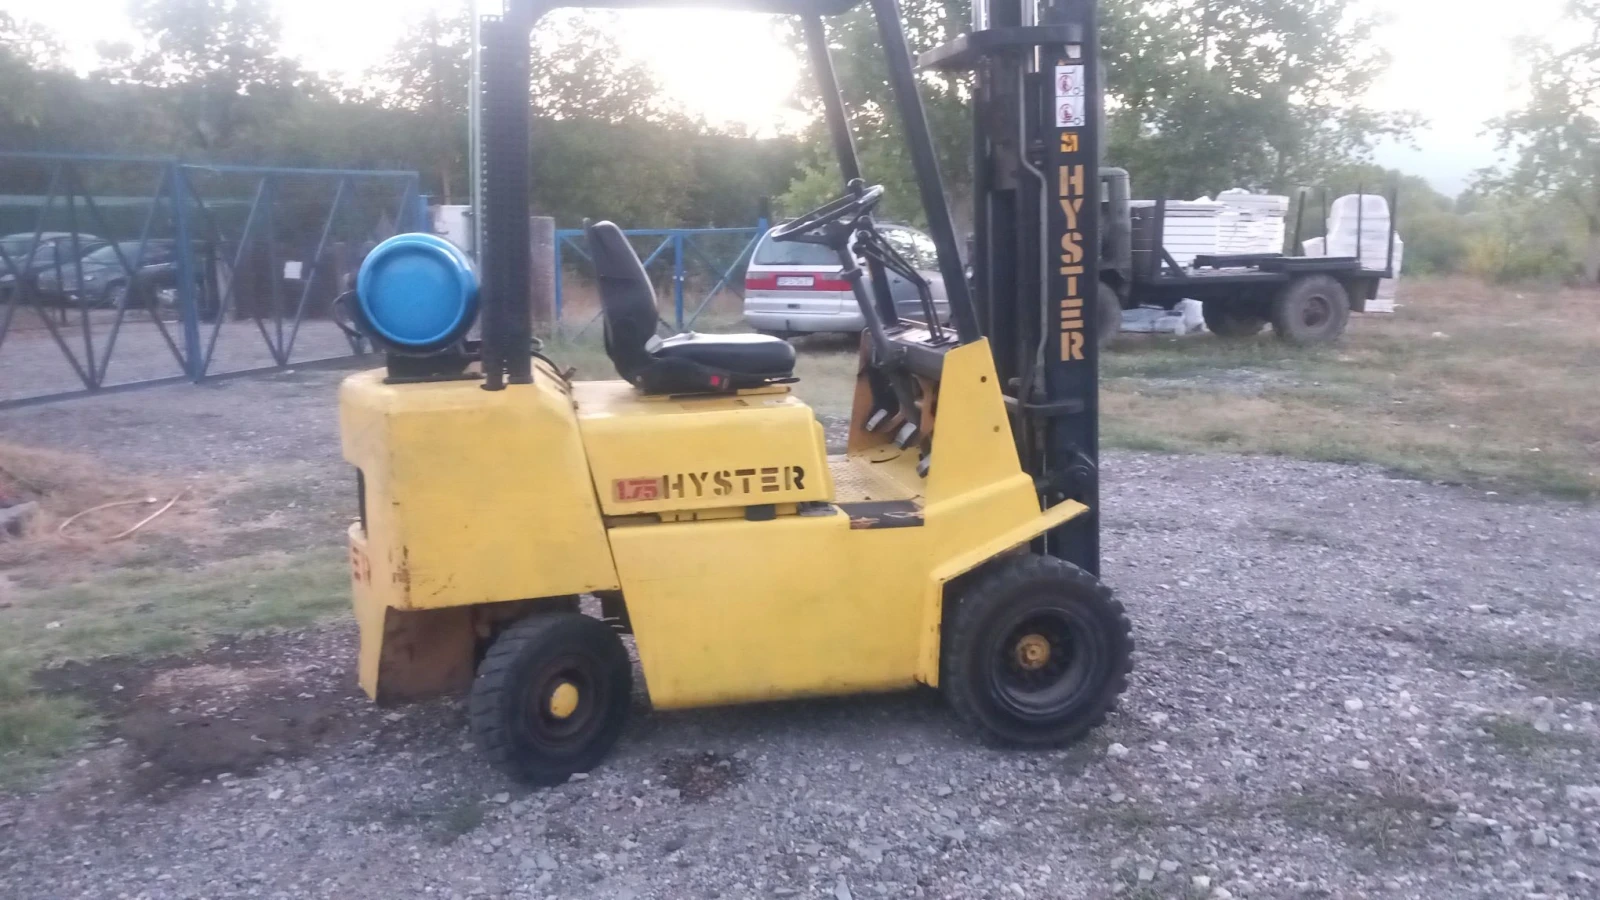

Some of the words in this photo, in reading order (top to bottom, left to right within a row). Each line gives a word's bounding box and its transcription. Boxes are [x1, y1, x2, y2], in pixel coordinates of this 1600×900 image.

[1059, 164, 1084, 361] HYSTER
[616, 478, 658, 500] 1.75
[662, 466, 805, 499] HYSTER
